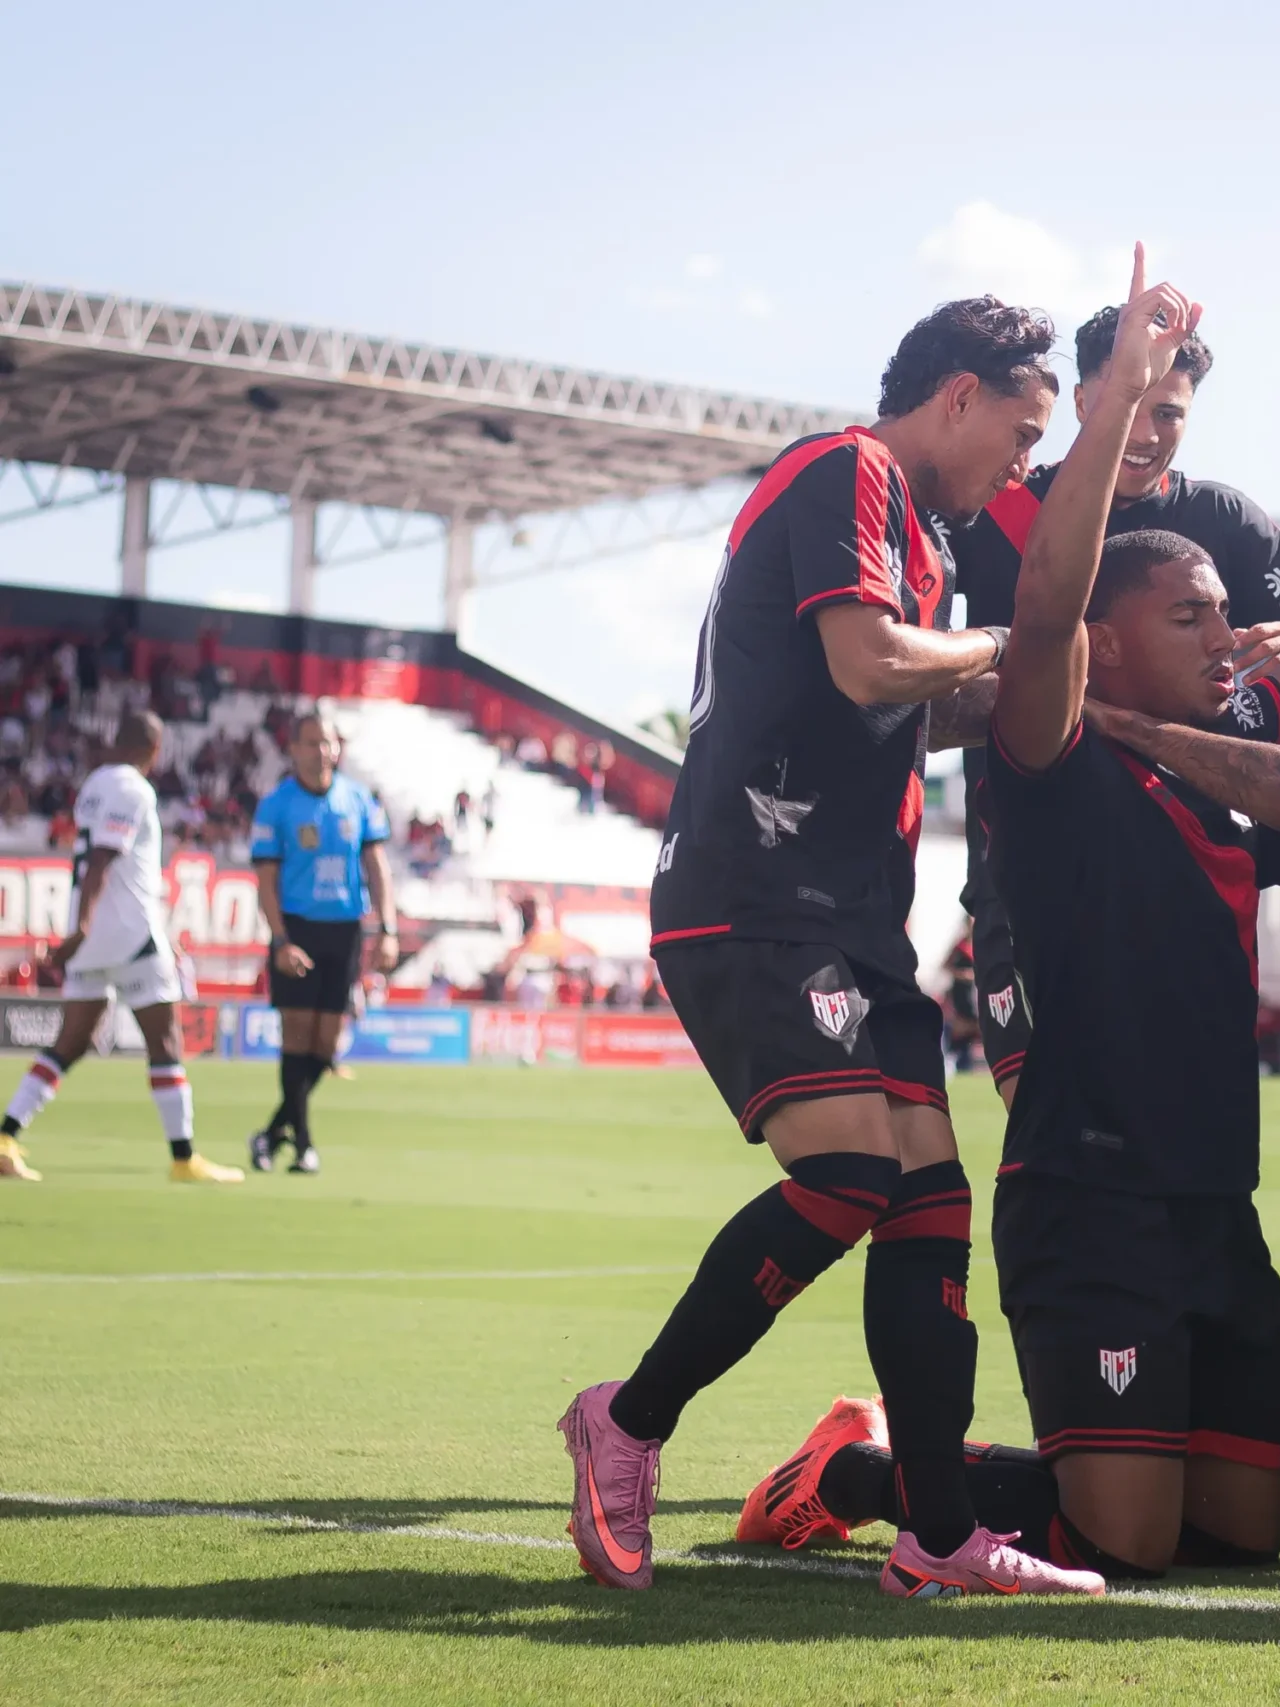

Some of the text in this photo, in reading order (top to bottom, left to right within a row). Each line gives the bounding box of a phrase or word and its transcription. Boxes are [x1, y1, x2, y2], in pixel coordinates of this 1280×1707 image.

[809, 990, 850, 1035] ACG
[753, 1256, 815, 1306] AC
[942, 1276, 968, 1320] AC
[1100, 1347, 1136, 1396] ACG
